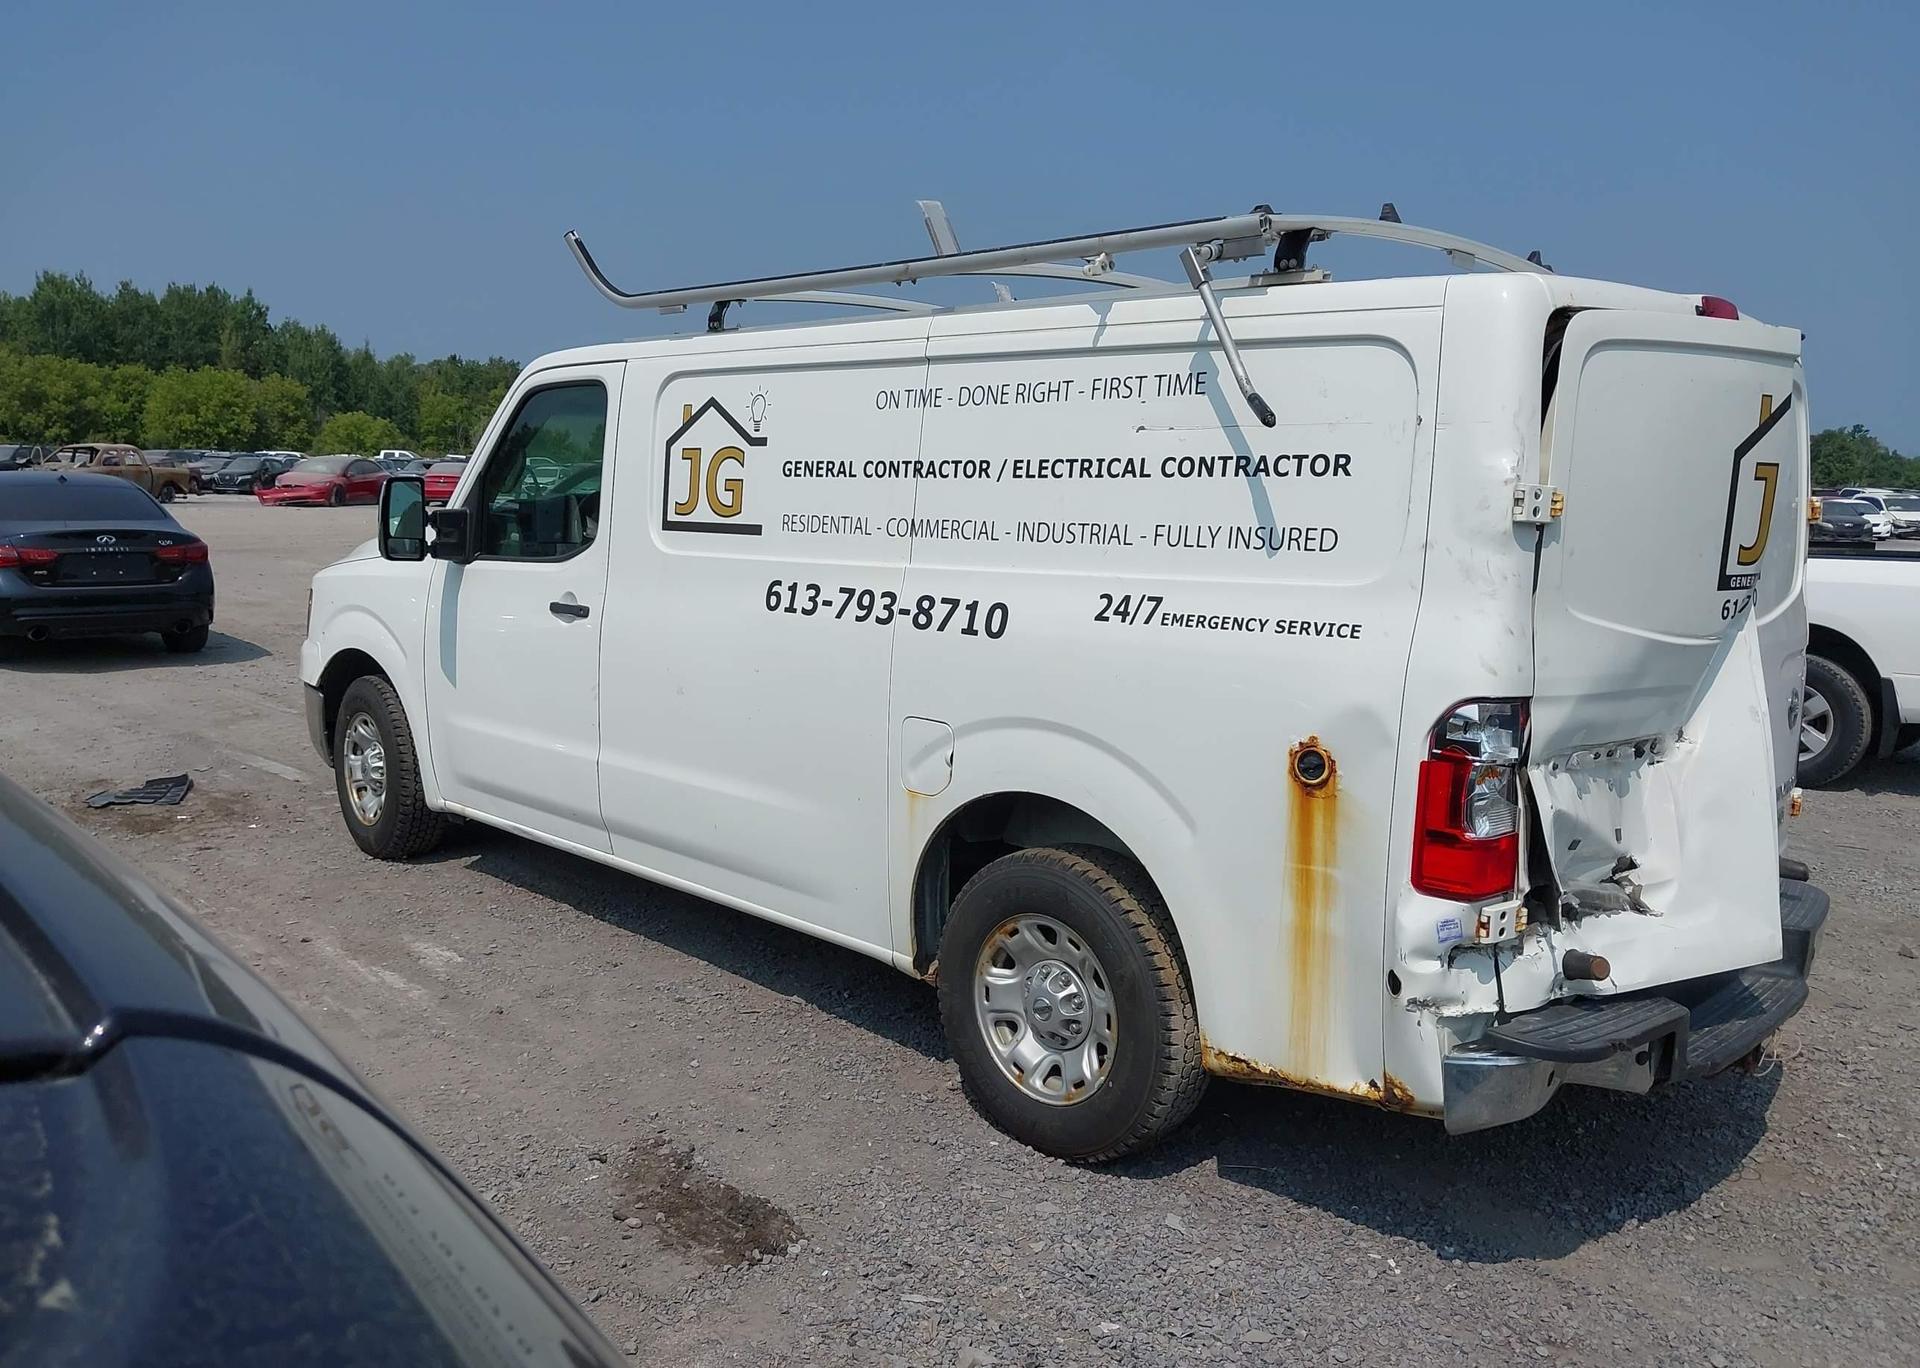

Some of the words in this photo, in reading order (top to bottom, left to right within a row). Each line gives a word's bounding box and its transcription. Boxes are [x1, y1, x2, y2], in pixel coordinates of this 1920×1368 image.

[875, 389, 900, 410] ON
[904, 387, 943, 408] TIME
[958, 384, 1010, 408] DONE
[1015, 379, 1074, 405] RIGHT
[1091, 375, 1148, 401] FIRST
[1154, 371, 1208, 397] TIME
[674, 446, 745, 518] JG
[782, 460, 857, 478] GENERAL
[863, 459, 991, 479] CONTRACTOR
[1012, 457, 1152, 479] ELECTRICAL
[1161, 453, 1353, 478] CONTRACTOR
[781, 514, 872, 536] RESIDENTIAL
[886, 518, 999, 541] COMMERCIAL
[1016, 521, 1133, 546] INDUSTRIAL
[1154, 525, 1222, 548] FULLY
[1228, 526, 1338, 552] INSURED
[765, 579, 1009, 639] 613-793-8710
[1093, 593, 1163, 626] 24/7
[1160, 612, 1270, 633] EMERGENCY
[1274, 619, 1362, 640] SERVICE
